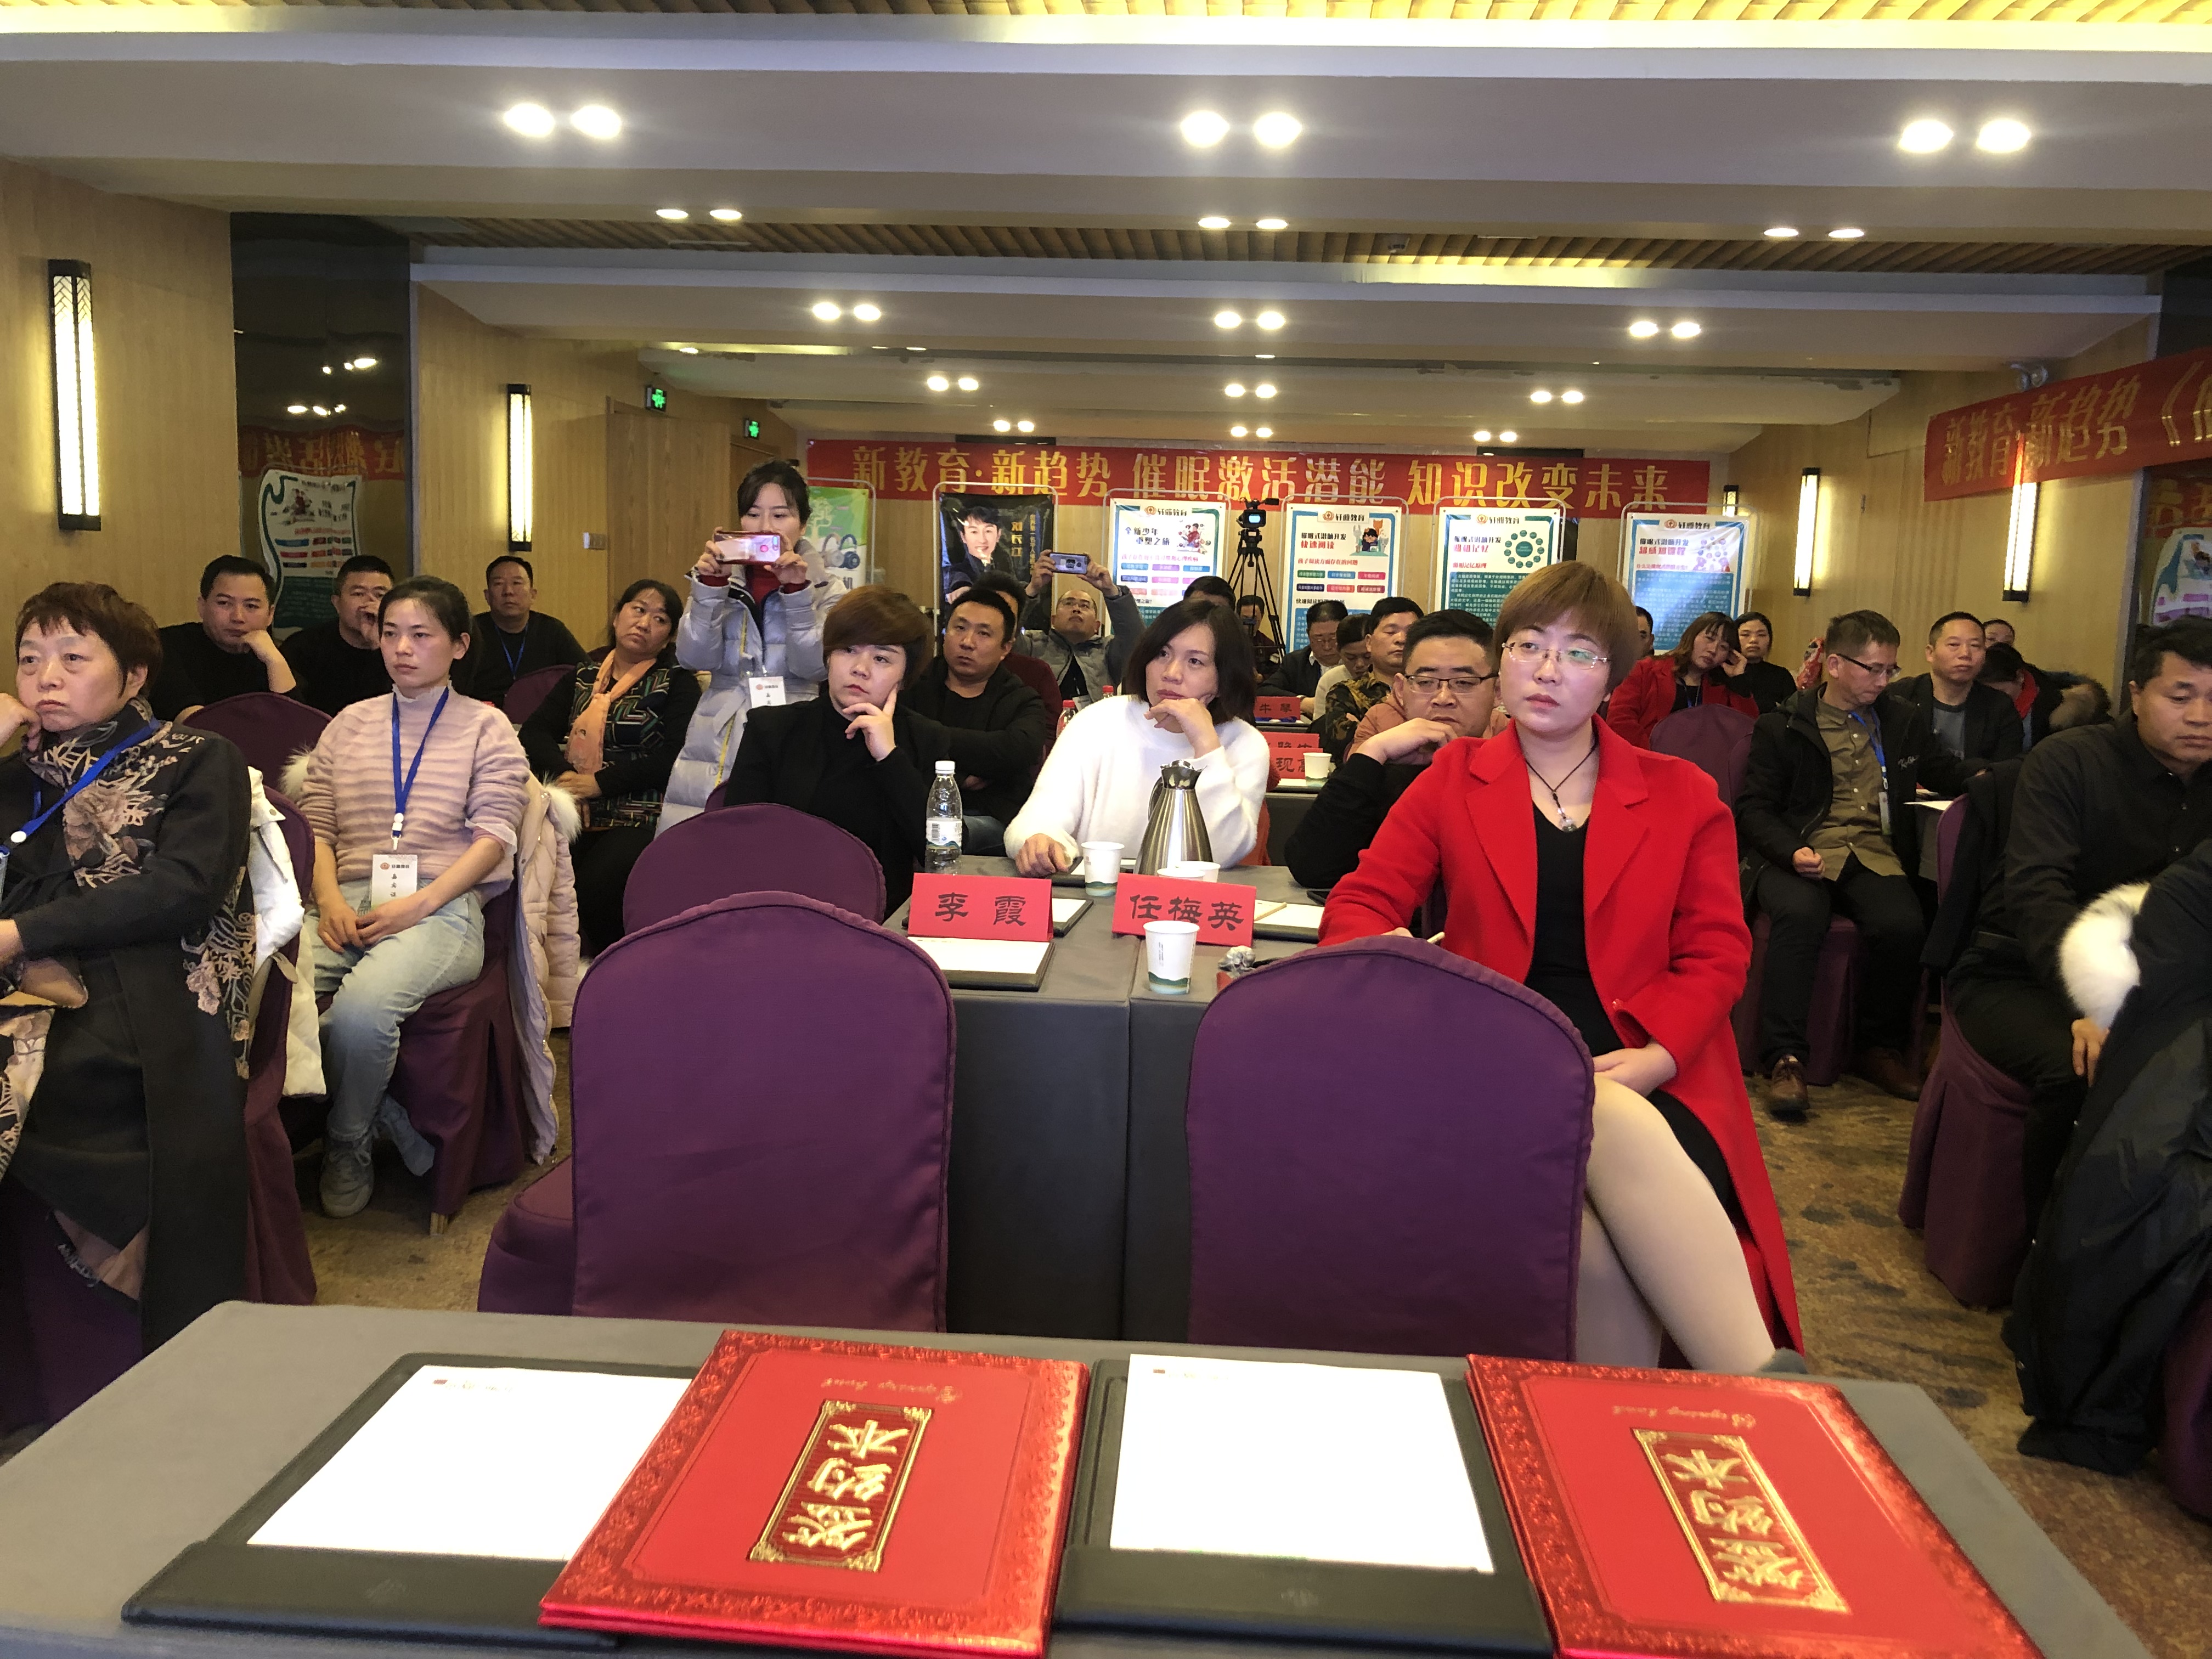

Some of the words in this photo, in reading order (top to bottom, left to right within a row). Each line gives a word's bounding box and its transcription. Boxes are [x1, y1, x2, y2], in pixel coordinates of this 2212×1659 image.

[853, 446, 1111, 497] 新教育·新趋势
[1132, 453, 1385, 505] 催眠激活潜能
[1407, 459, 1668, 511] 知识改变未来
[1300, 540, 1335, 549] 快速阅读
[935, 891, 1026, 927] 李霞
[1129, 893, 1245, 932] 任梅英
[782, 1419, 909, 1551] 签约本
[1661, 1449, 1805, 1589] 签约本
